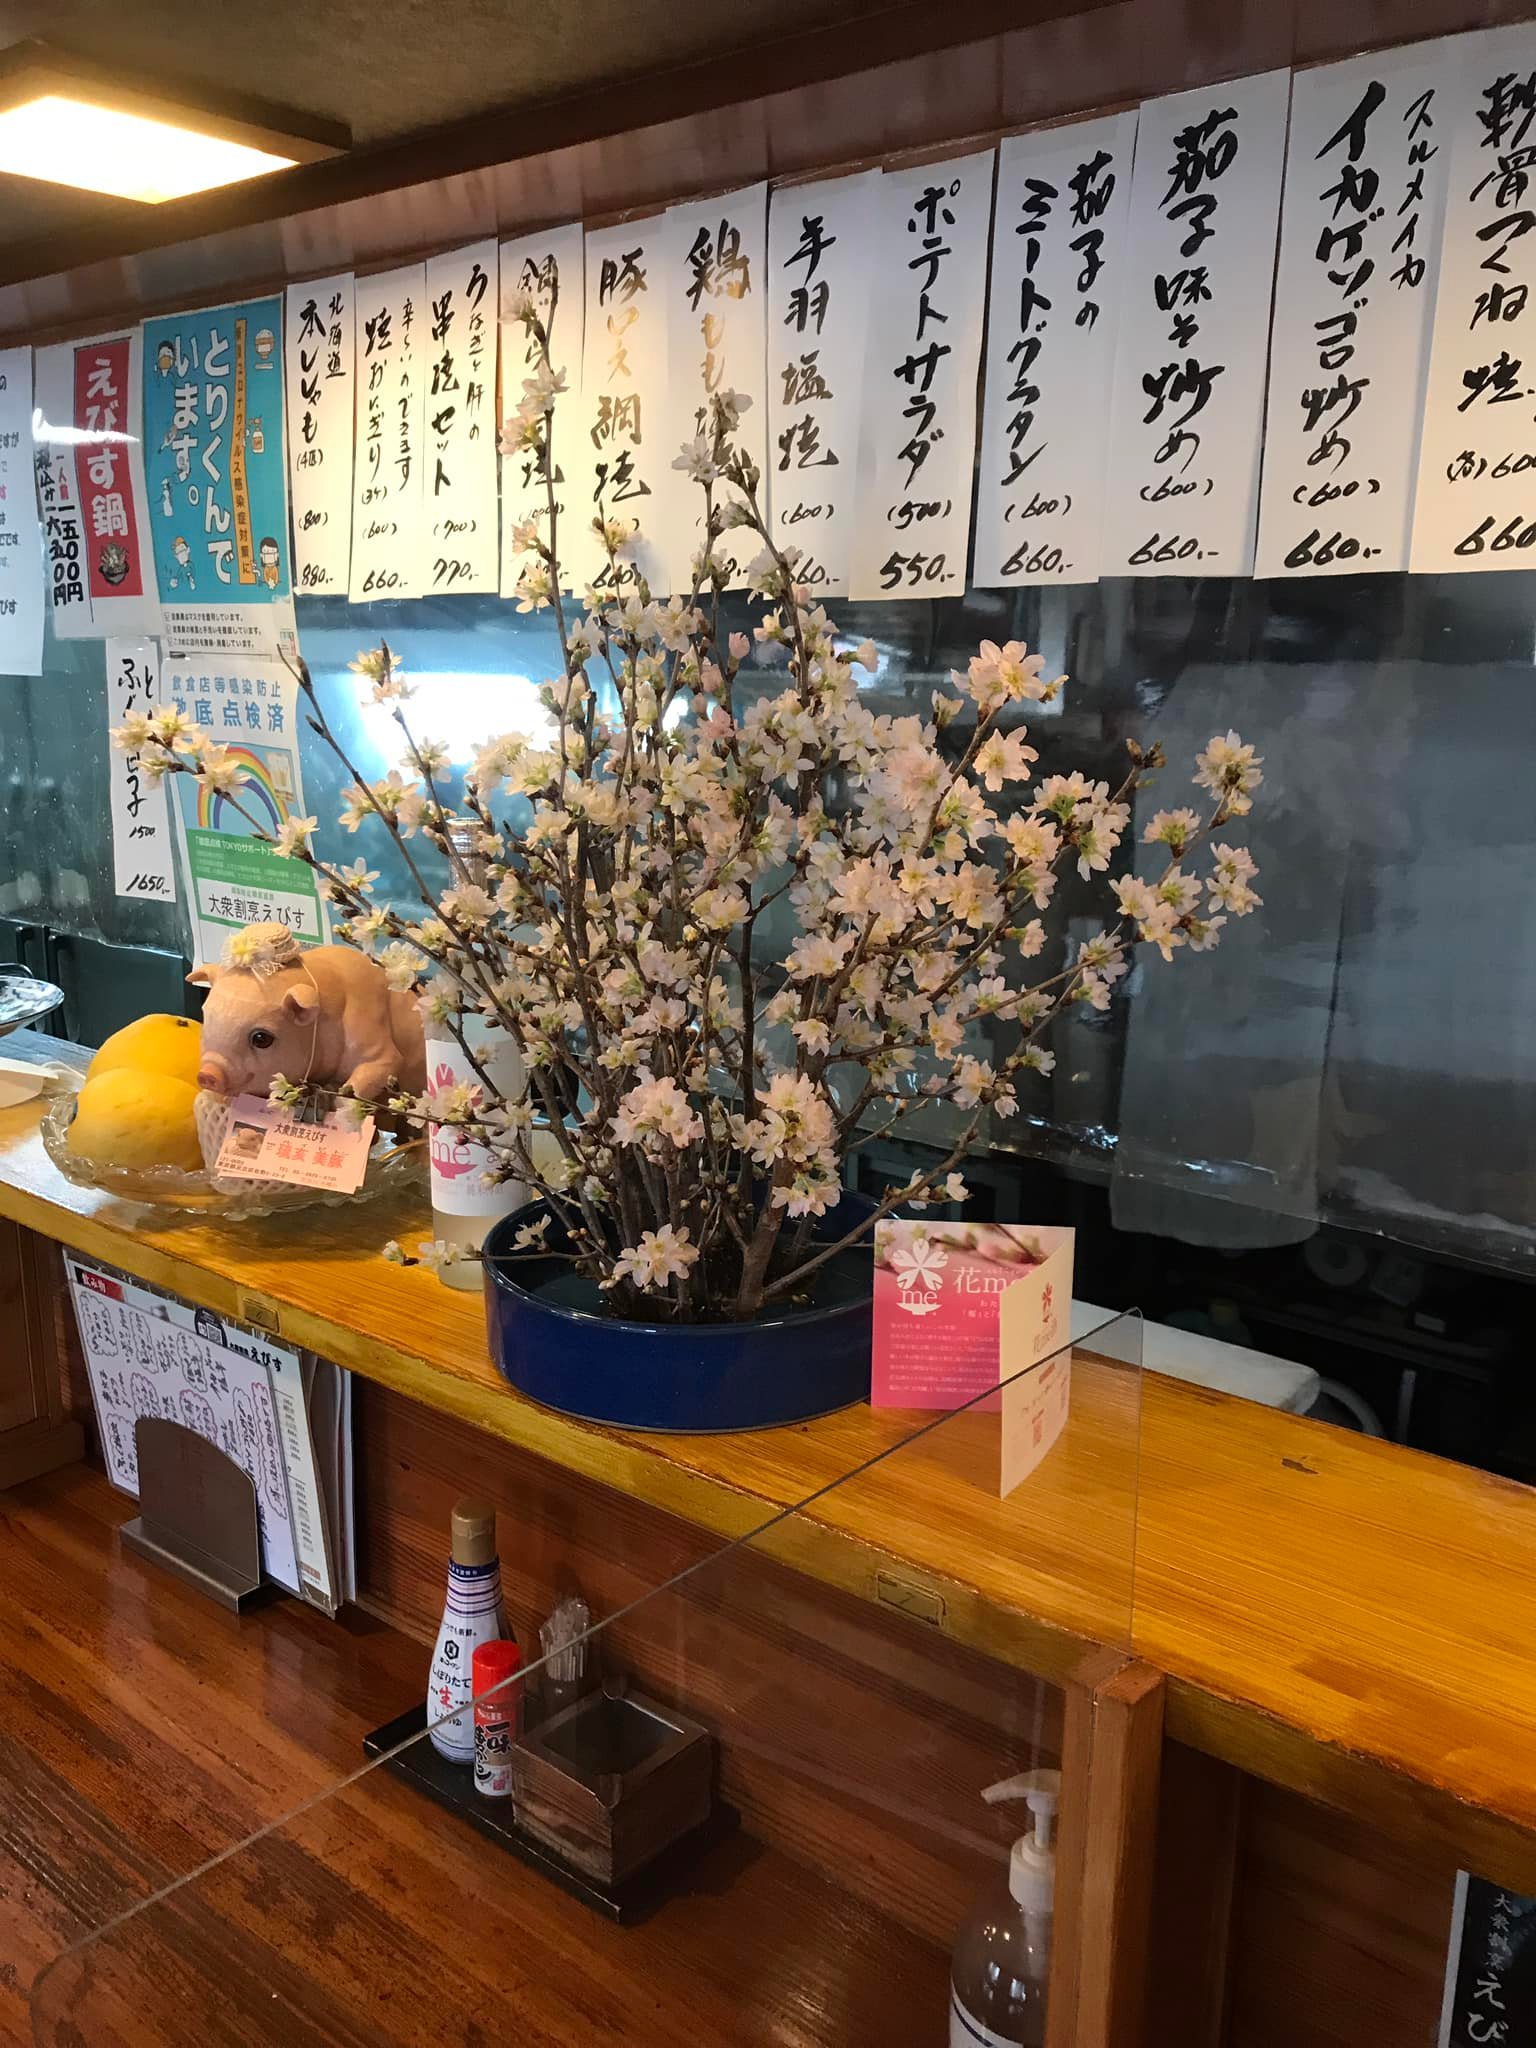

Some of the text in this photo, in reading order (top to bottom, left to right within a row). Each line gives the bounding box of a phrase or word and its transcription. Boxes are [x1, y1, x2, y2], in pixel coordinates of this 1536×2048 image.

[1390, 89, 1438, 290] スルメイカ
[1068, 150, 1116, 335] 茄子の
[326, 292, 346, 379] 北海道
[894, 178, 961, 489] ポテトサラダ
[1001, 178, 1058, 486] ミートグラタン
[172, 335, 200, 506] います。
[86, 358, 129, 537] えびす鍋
[202, 328, 232, 584] とりくんで
[1139, 476, 1214, 502] (600)
[1292, 479, 1380, 507] (600)
[299, 511, 329, 531] (800)
[781, 503, 834, 525] (600)
[887, 499, 952, 529] (500)
[1005, 493, 1071, 523] (600)
[363, 521, 397, 539] (600)
[433, 519, 477, 537] (700)
[208, 893, 306, 929] 大衆割烹えびす
[901, 1290, 938, 1304] me
[433, 1664, 472, 1689] しぼりたて
